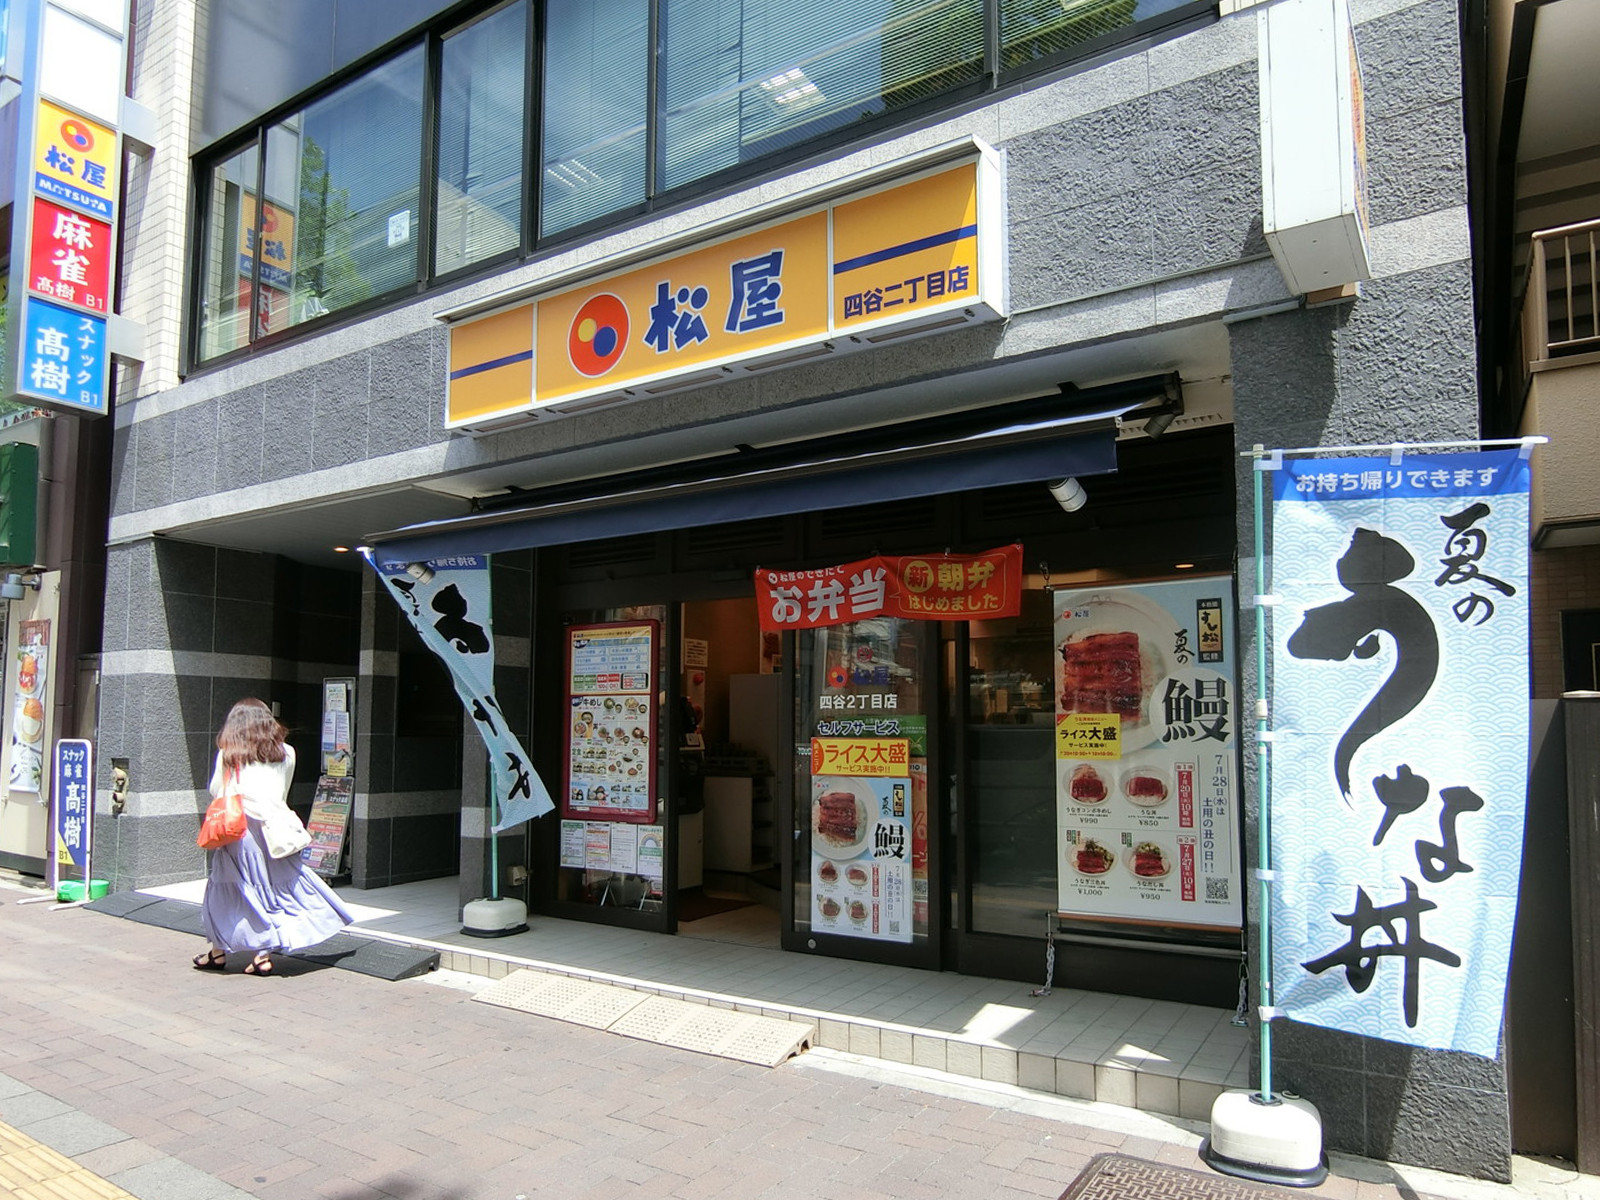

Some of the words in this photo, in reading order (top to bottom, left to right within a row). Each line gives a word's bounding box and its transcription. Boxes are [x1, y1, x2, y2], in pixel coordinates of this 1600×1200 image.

[44, 145, 107, 189] 松屋
[39, 179, 107, 212] MATSUYA
[51, 212, 95, 286] 麻雀
[86, 293, 104, 309] B1
[644, 248, 785, 354] 松屋
[844, 265, 969, 320] 四谷二丁目店
[77, 317, 96, 385] スナック
[80, 390, 98, 405] B1
[1296, 465, 1499, 494] お持ち帰りできます
[907, 564, 929, 590] 新
[938, 561, 996, 591] 朝弁
[1435, 502, 1516, 626] 夏の
[770, 567, 887, 624] お弁当
[908, 592, 998, 612] はじめました
[1174, 628, 1195, 665] 夏の
[820, 694, 898, 710] 四谷2丁目店
[1162, 677, 1232, 743] 鰻
[817, 720, 900, 736] セルフサービス
[1060, 726, 1117, 740] ライス大盛
[63, 750, 84, 761] スナック
[825, 743, 906, 764] ライス大盛
[64, 763, 82, 778] 麻雀
[1287, 527, 1484, 1028] うな丼
[1139, 819, 1159, 827] ¥850
[59, 850, 68, 860] B1
[874, 823, 904, 859] 鰻
